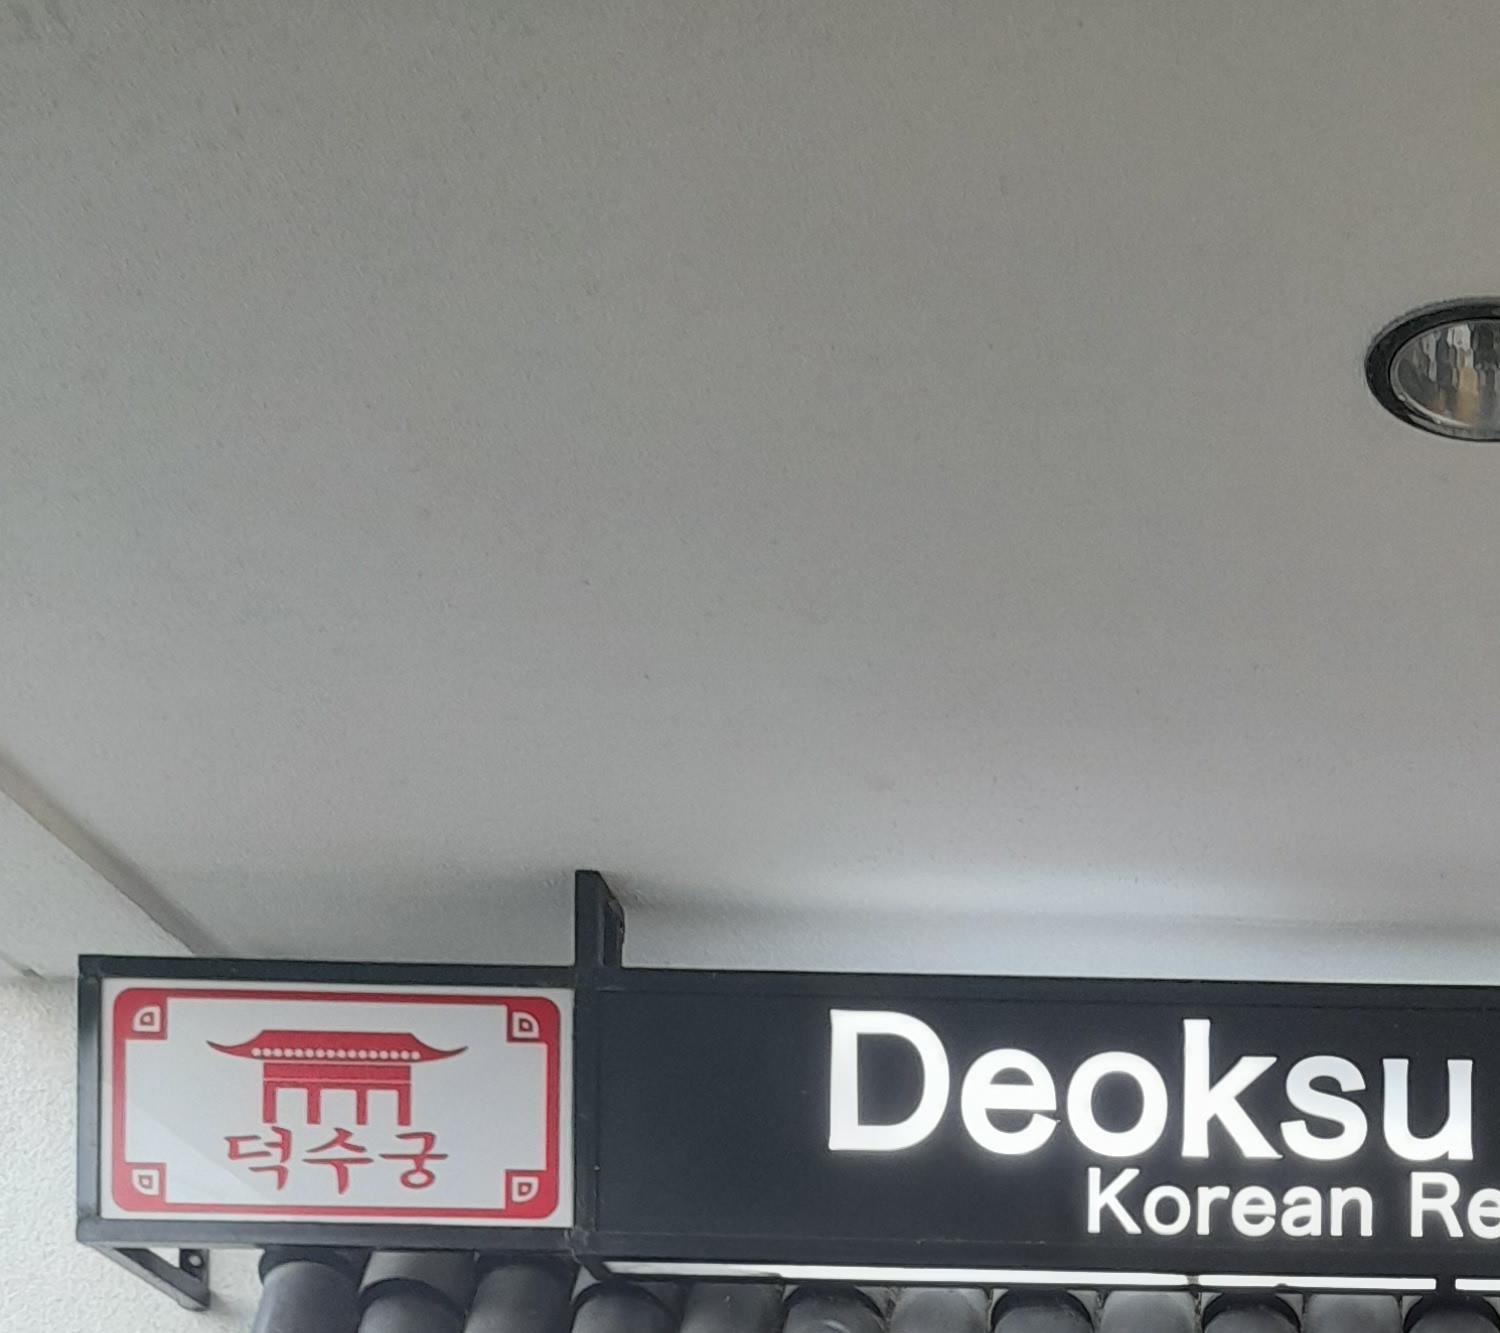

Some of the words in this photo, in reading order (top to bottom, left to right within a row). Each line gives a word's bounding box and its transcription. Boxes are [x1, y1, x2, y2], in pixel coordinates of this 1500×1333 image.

[828, 1008, 1474, 1162] Deoksu
[224, 1126, 448, 1195] 덕수궁
[1087, 1166, 1374, 1238] Korean
